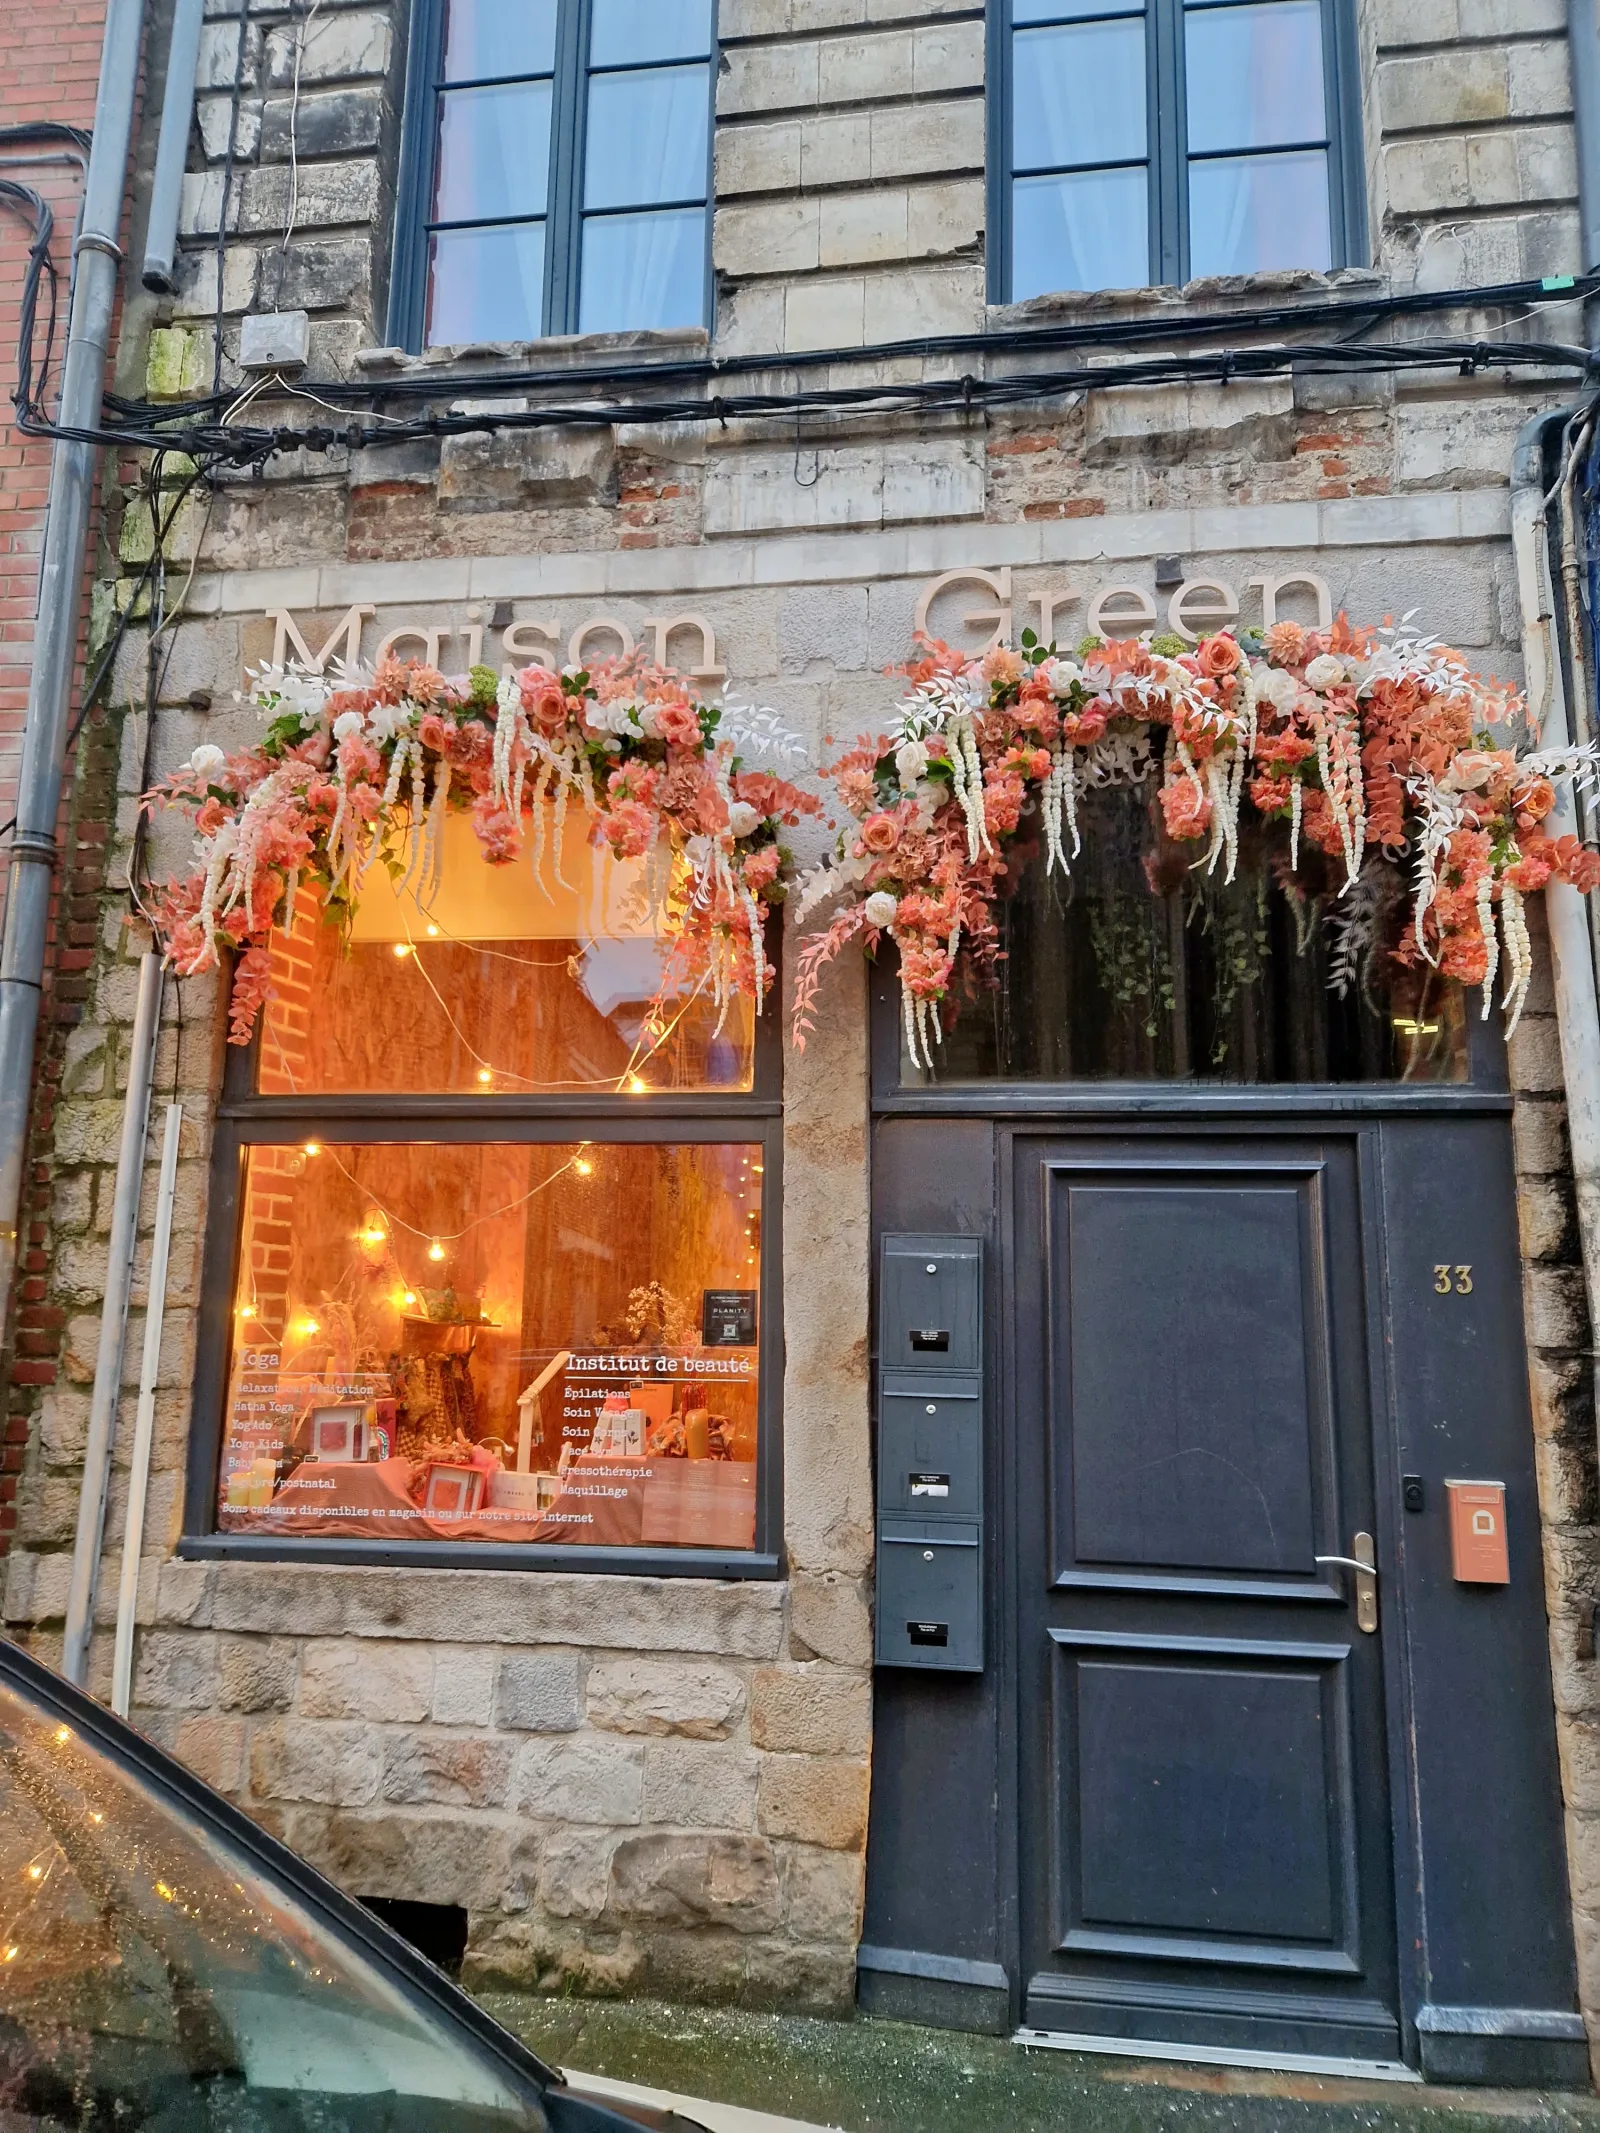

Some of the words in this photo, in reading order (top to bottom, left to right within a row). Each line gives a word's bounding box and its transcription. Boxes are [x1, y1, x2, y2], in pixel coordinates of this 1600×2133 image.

[265, 604, 727, 680] Maison
[914, 565, 1334, 661] Green
[1434, 1264, 1473, 1294] 33
[240, 1349, 279, 1369] Yoga
[566, 1354, 650, 1372] Institut
[655, 1357, 678, 1372] de
[684, 1357, 749, 1373] beauté
[236, 1383, 305, 1393] Relaxaton/
[309, 1384, 374, 1395] Mditation
[564, 1385, 630, 1400] Épilations
[234, 1401, 266, 1411] Hatha
[269, 1401, 294, 1413] Yoga
[563, 1407, 591, 1417] Soin
[594, 1407, 634, 1420] Vage
[562, 1426, 590, 1436] Soin
[230, 1438, 254, 1450] Yoga
[259, 1438, 284, 1449] Kids
[561, 1446, 588, 1455] ace
[560, 1465, 652, 1479] Pressothérapie
[560, 1485, 628, 1498] Maquillage
[222, 1503, 248, 1513] Bons
[251, 1505, 296, 1515] cadeaux
[299, 1505, 369, 1518] disponibles
[372, 1508, 385, 1517] en
[388, 1508, 434, 1519] magasin
[438, 1510, 452, 1518] ou
[456, 1510, 475, 1519] sur
[479, 1511, 510, 1520] notre
[514, 1511, 538, 1520] site
